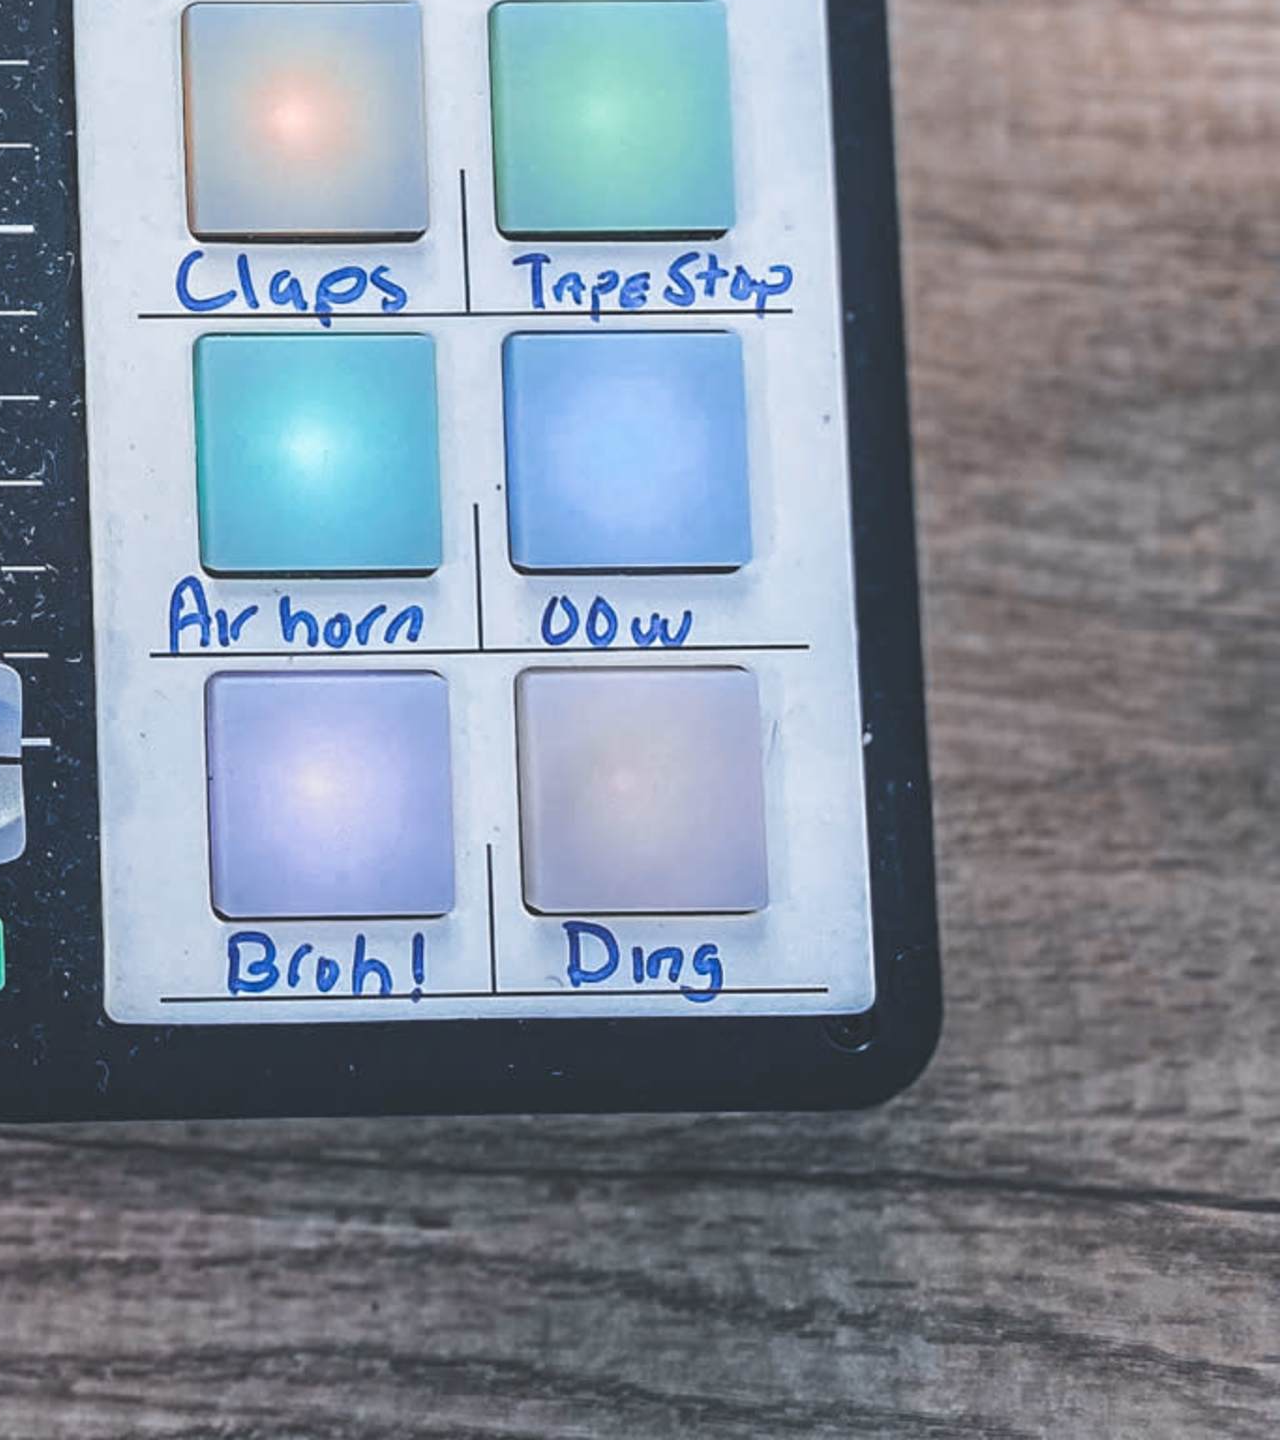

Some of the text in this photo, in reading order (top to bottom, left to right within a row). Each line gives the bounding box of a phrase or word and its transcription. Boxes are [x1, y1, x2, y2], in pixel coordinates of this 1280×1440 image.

[176, 250, 409, 327] Claps
[227, 931, 426, 1003] Broh!
[564, 922, 723, 1002] Ding
